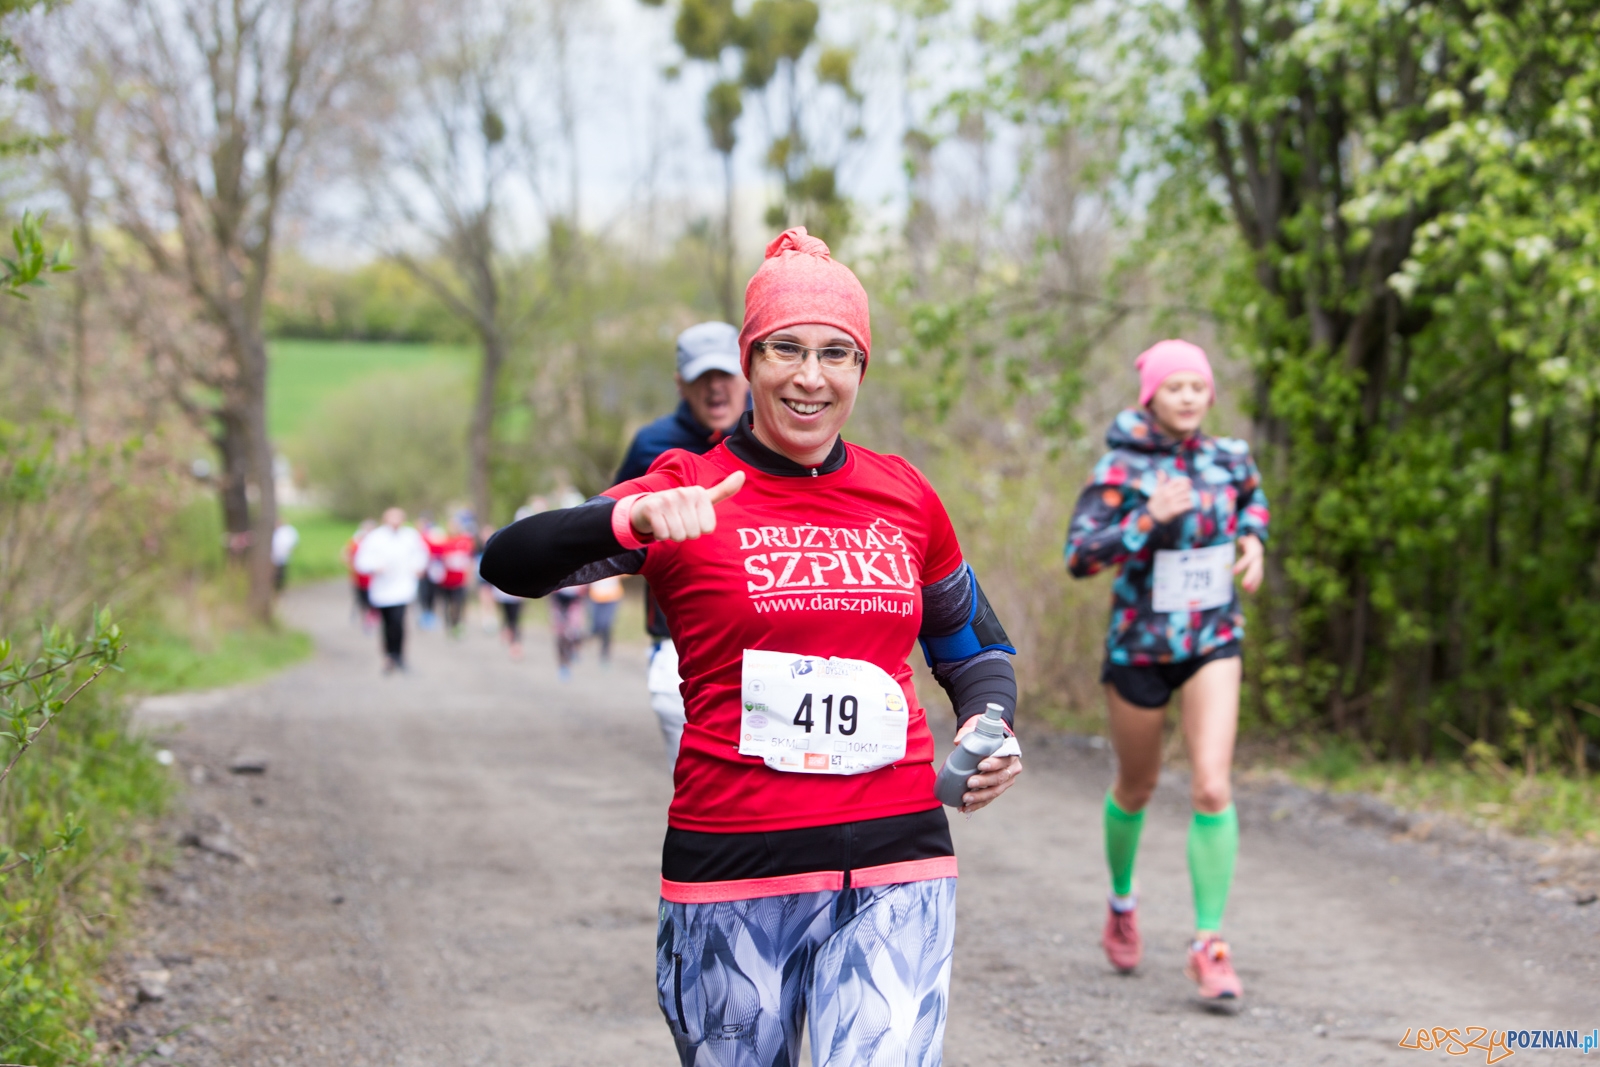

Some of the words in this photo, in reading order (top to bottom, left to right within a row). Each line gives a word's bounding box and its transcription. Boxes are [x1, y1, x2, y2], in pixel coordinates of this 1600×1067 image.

[736, 523, 886, 550] DRUŻYNA
[744, 550, 915, 593] SZPIKU
[753, 594, 914, 618] www.darszpiku.pl
[793, 693, 858, 736] 419
[771, 737, 796, 748] 5KM
[848, 742, 878, 753] 10KM
